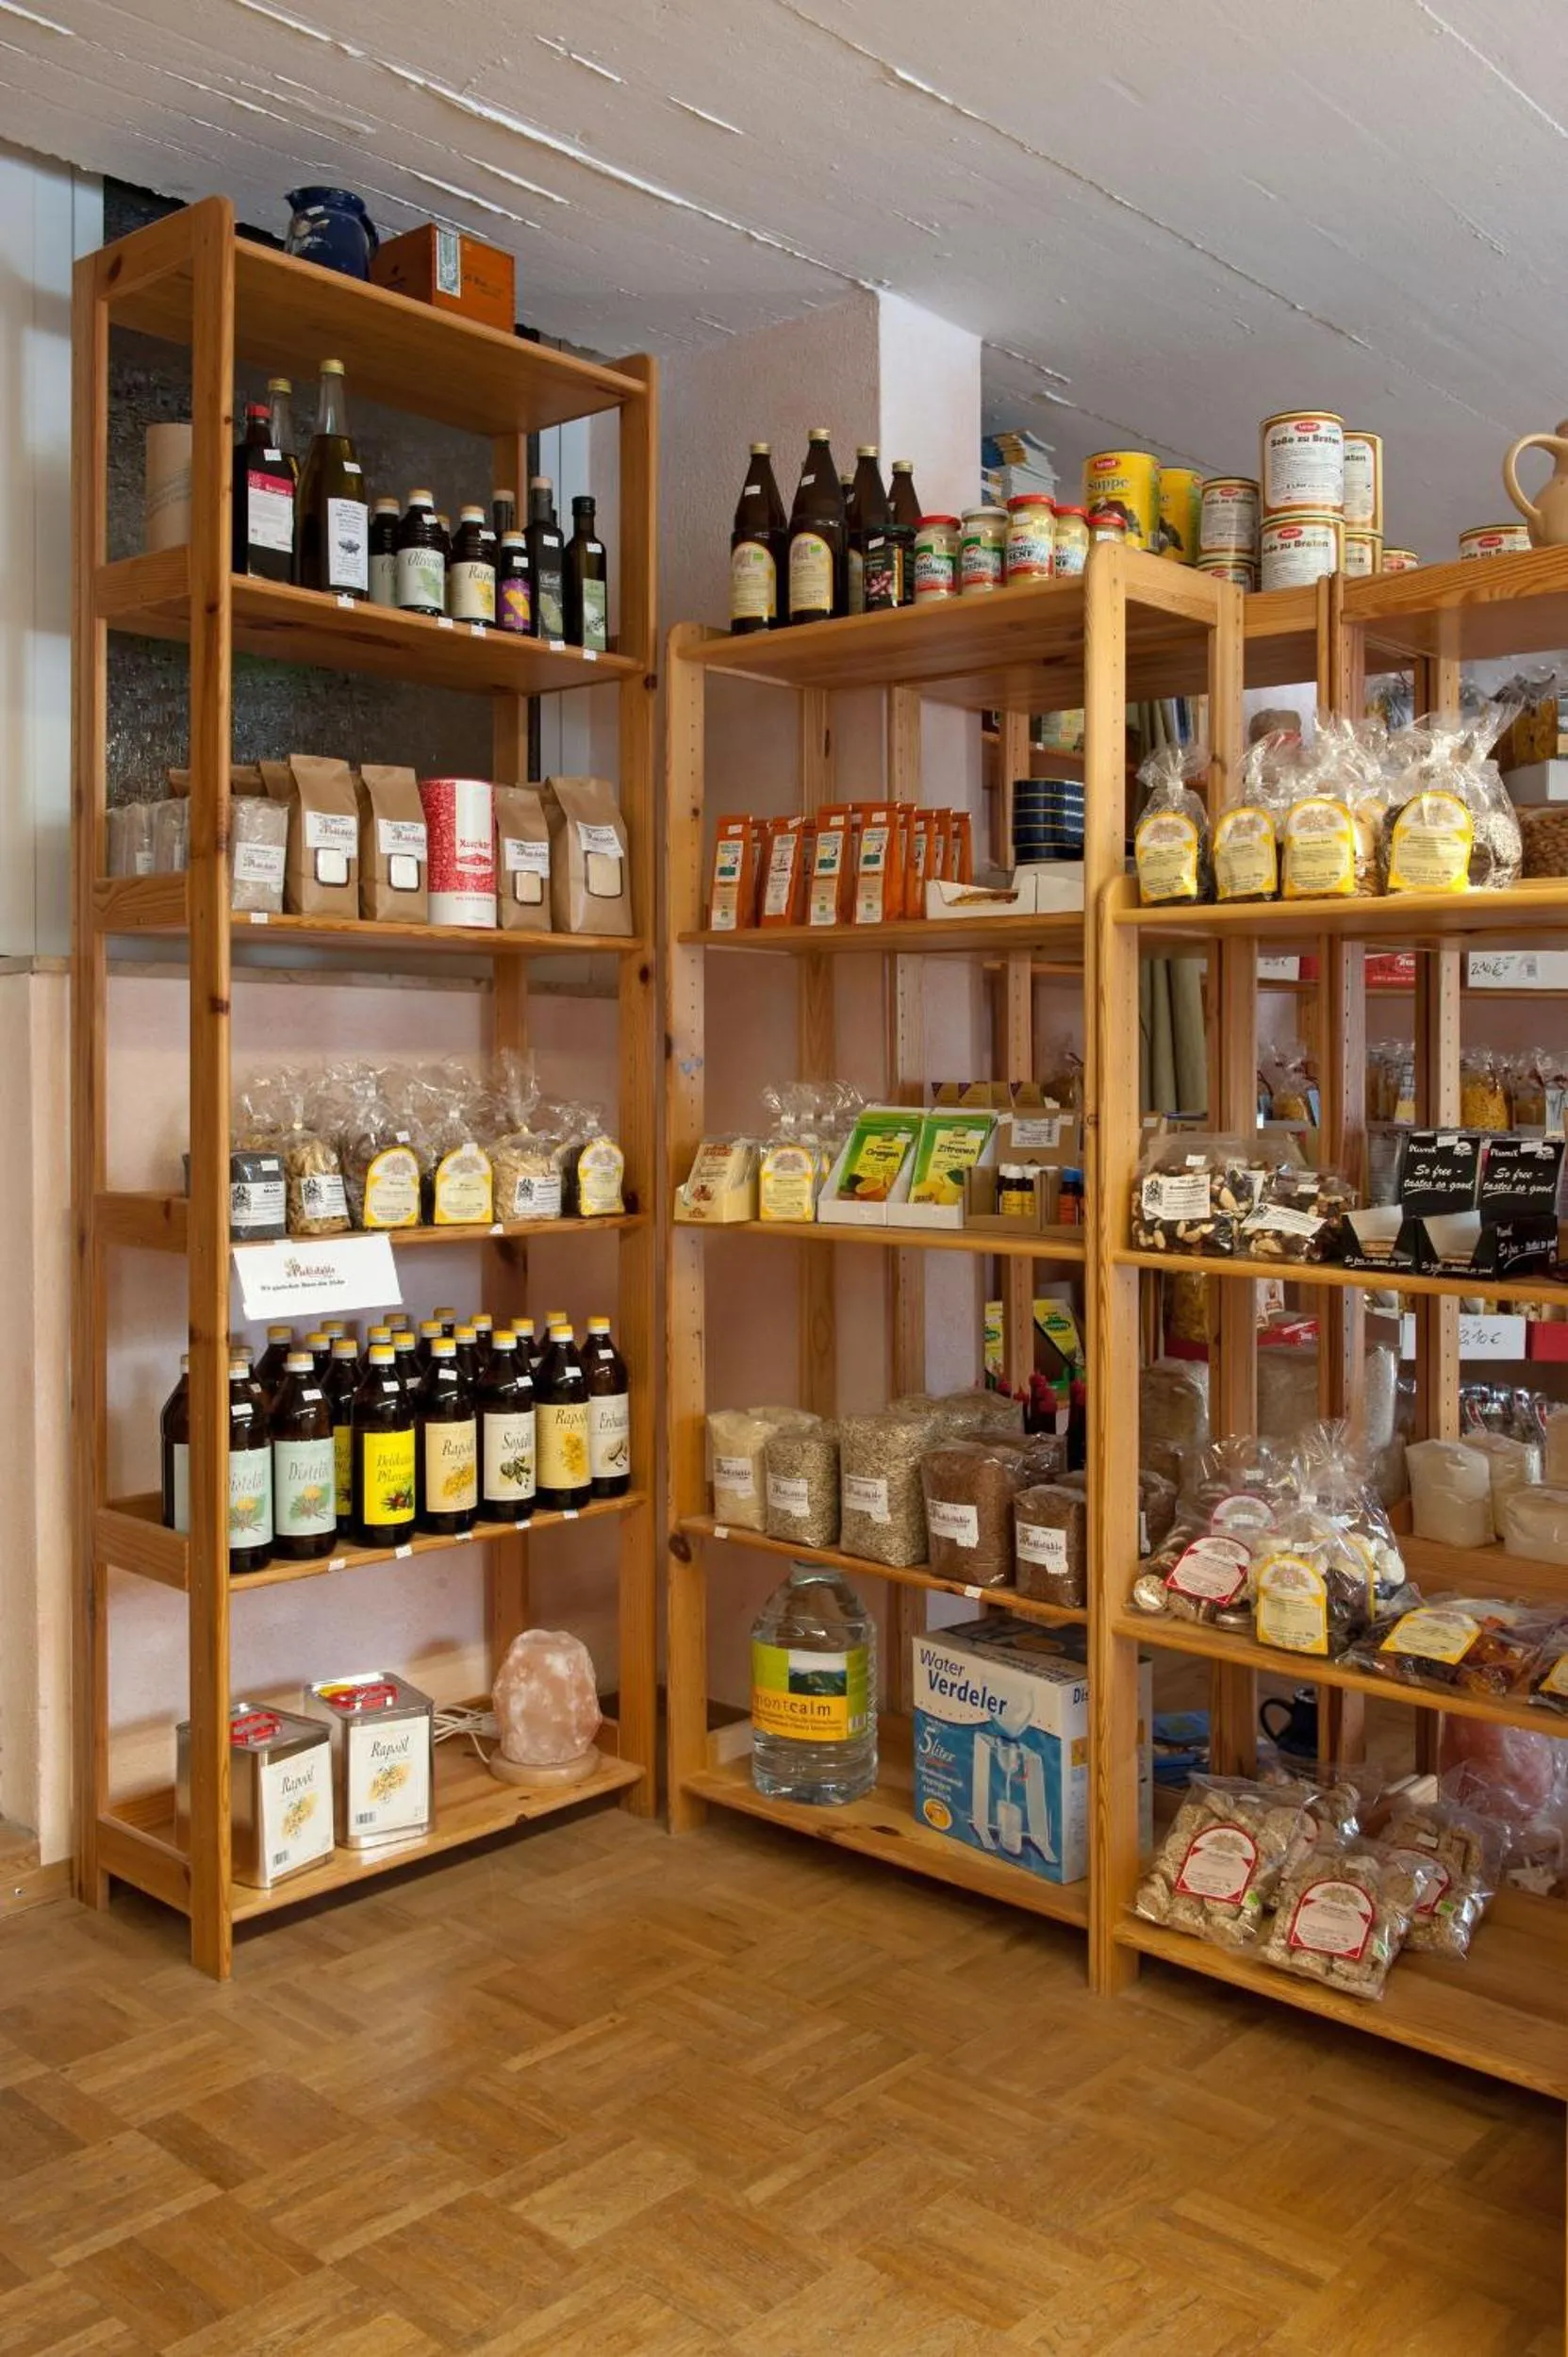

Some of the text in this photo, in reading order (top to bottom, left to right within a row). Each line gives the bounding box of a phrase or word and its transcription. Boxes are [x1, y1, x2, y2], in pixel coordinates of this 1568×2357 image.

[1270, 434, 1340, 447] Soße zu Braten
[1414, 1164, 1430, 1176] So
[1432, 1165, 1452, 1178] free
[1494, 1167, 1510, 1178] So
[1512, 1169, 1533, 1180] free
[1404, 1178, 1432, 1189] tastes
[1449, 1179, 1474, 1192] good
[1482, 1182, 1554, 1195] tastes so good
[919, 1647, 966, 1678] Water
[928, 1669, 1008, 1716] Verdeler
[754, 1695, 831, 1717] montcalm
[371, 1734, 410, 1760] Rapsöl
[918, 1726, 936, 1755] 5
